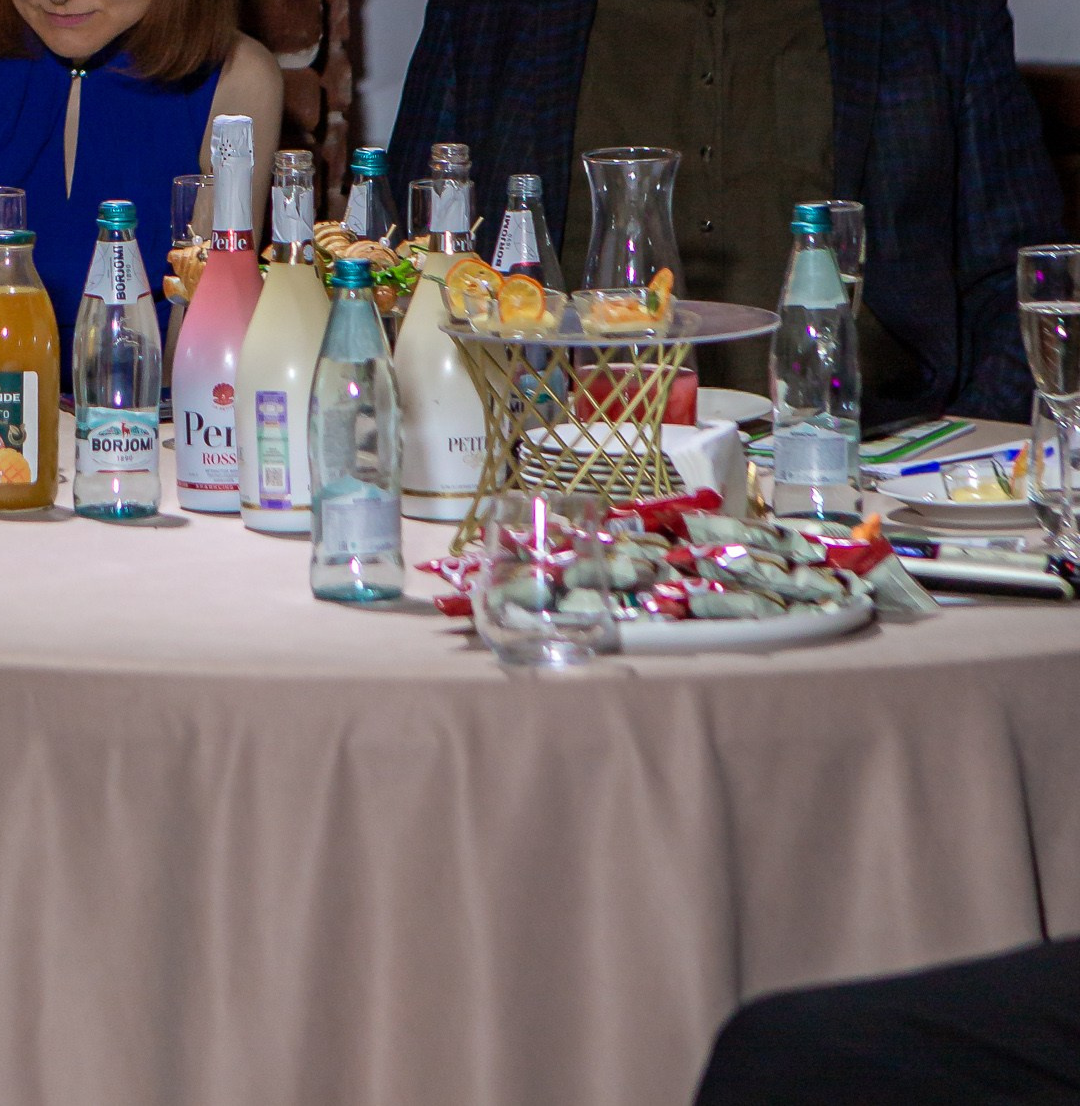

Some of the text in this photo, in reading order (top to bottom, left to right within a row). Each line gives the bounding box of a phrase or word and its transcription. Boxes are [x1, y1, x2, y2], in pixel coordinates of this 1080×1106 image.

[495, 214, 511, 267] BORJOMI
[113, 245, 126, 300] BORJOMI
[91, 437, 153, 452] BORJOMI
[183, 410, 236, 448] Per
[201, 452, 237, 465] ROSS
